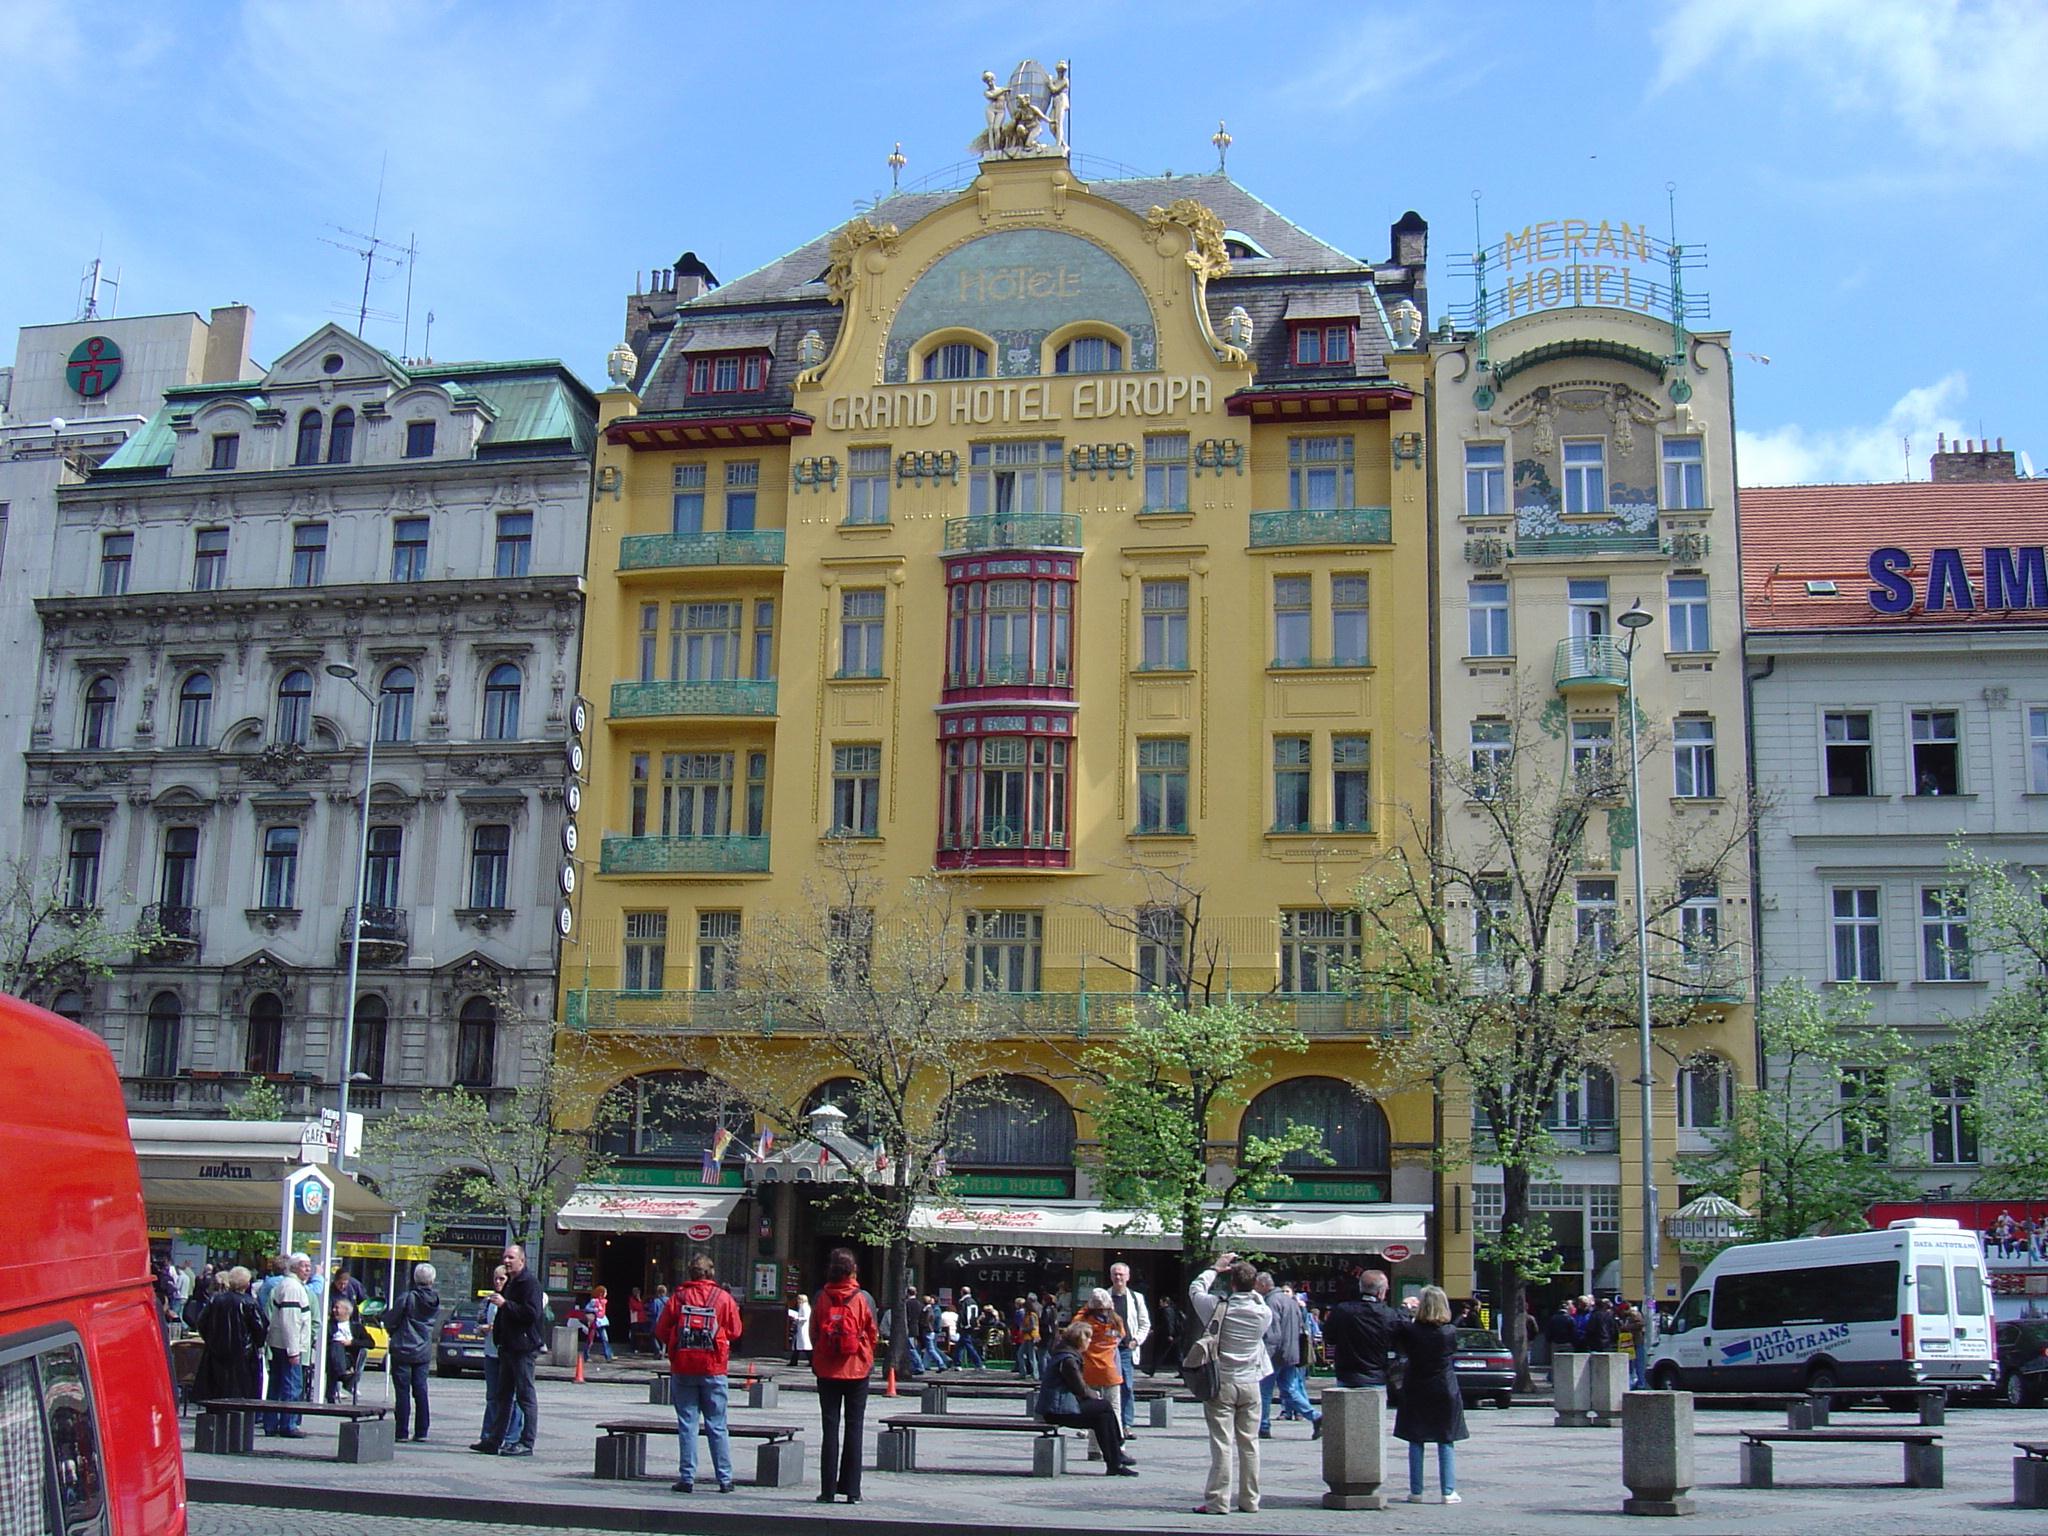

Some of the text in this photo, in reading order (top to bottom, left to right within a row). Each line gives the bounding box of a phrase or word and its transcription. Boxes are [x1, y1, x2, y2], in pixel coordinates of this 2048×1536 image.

[1505, 219, 1647, 271] MERAN
[959, 264, 1081, 302] HOTEL
[1507, 264, 1649, 317] HOTEL
[826, 388, 937, 431] GRAND
[950, 382, 1062, 425] HOTEL
[1867, 546, 2048, 615] SAM
[199, 1161, 252, 1179] LAVAZZA
[1751, 1328, 1793, 1350] DATA
[1755, 1324, 1850, 1364] AUTOTRANS
